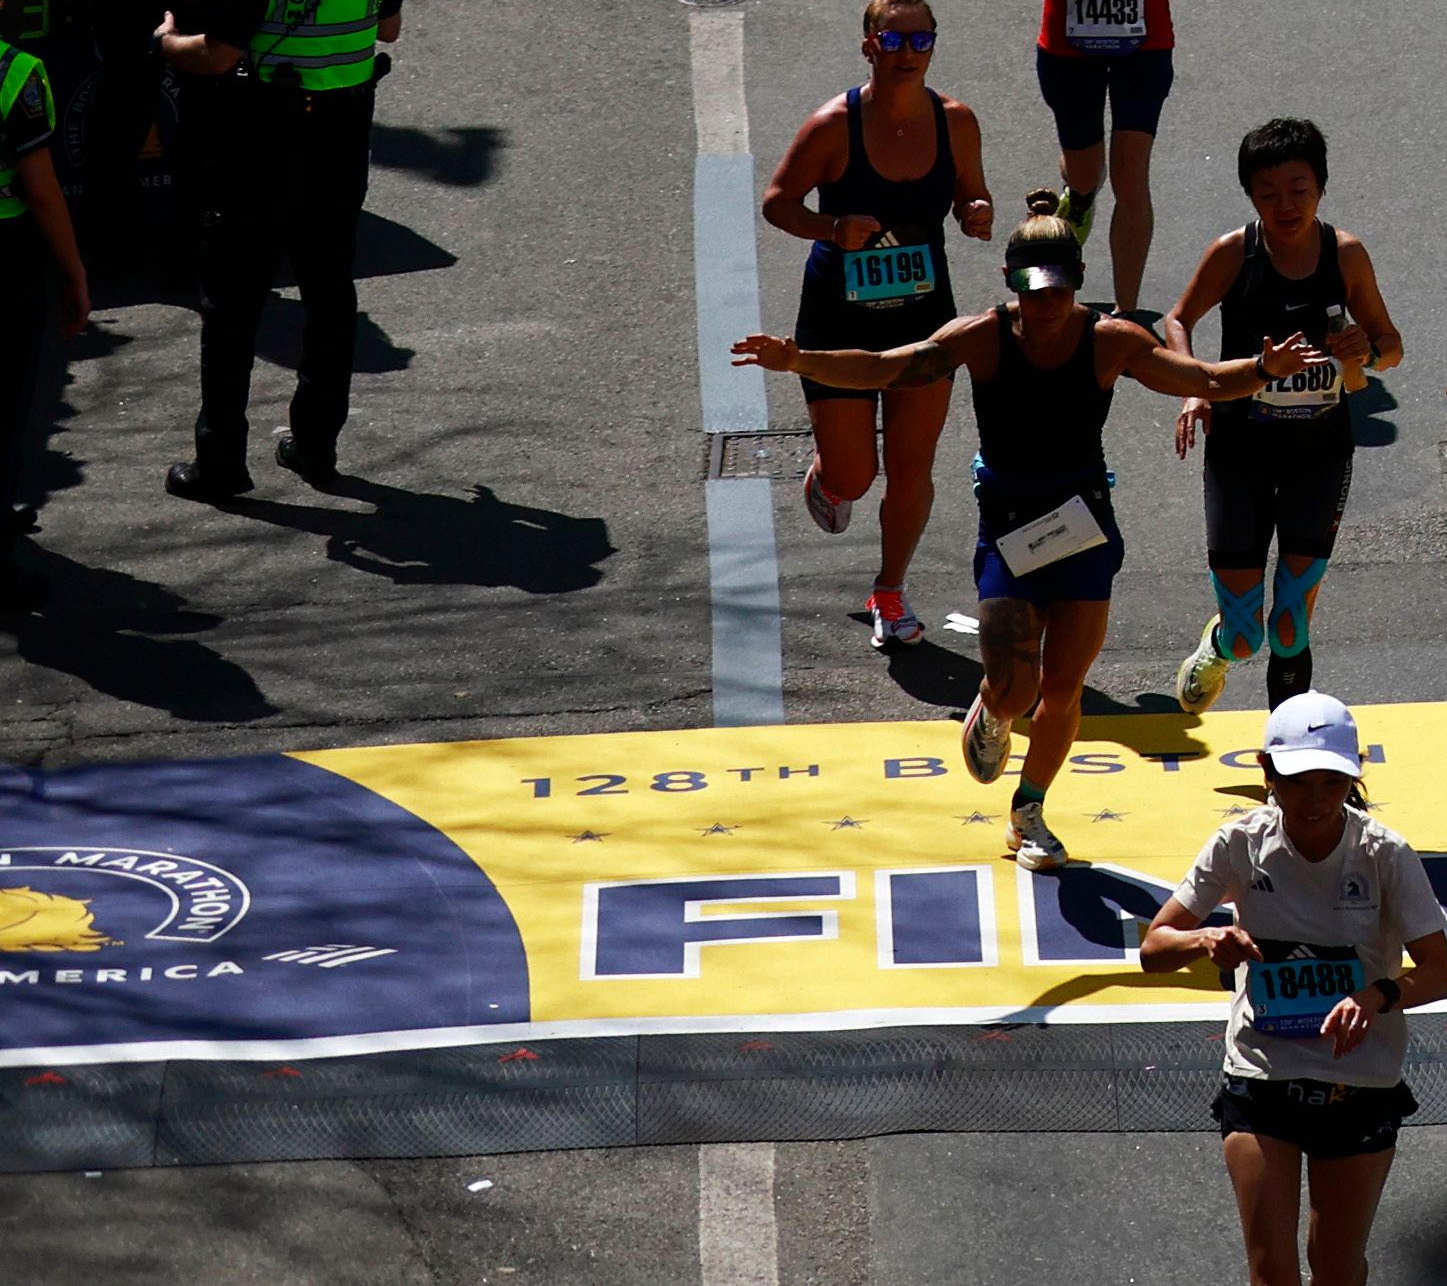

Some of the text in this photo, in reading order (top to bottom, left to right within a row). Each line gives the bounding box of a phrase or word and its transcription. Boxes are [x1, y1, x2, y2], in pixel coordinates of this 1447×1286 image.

[851, 251, 928, 288] 16199
[523, 765, 823, 800] 128TH
[60, 851, 233, 934] MARATHON
[1260, 961, 1352, 1001] 18488
